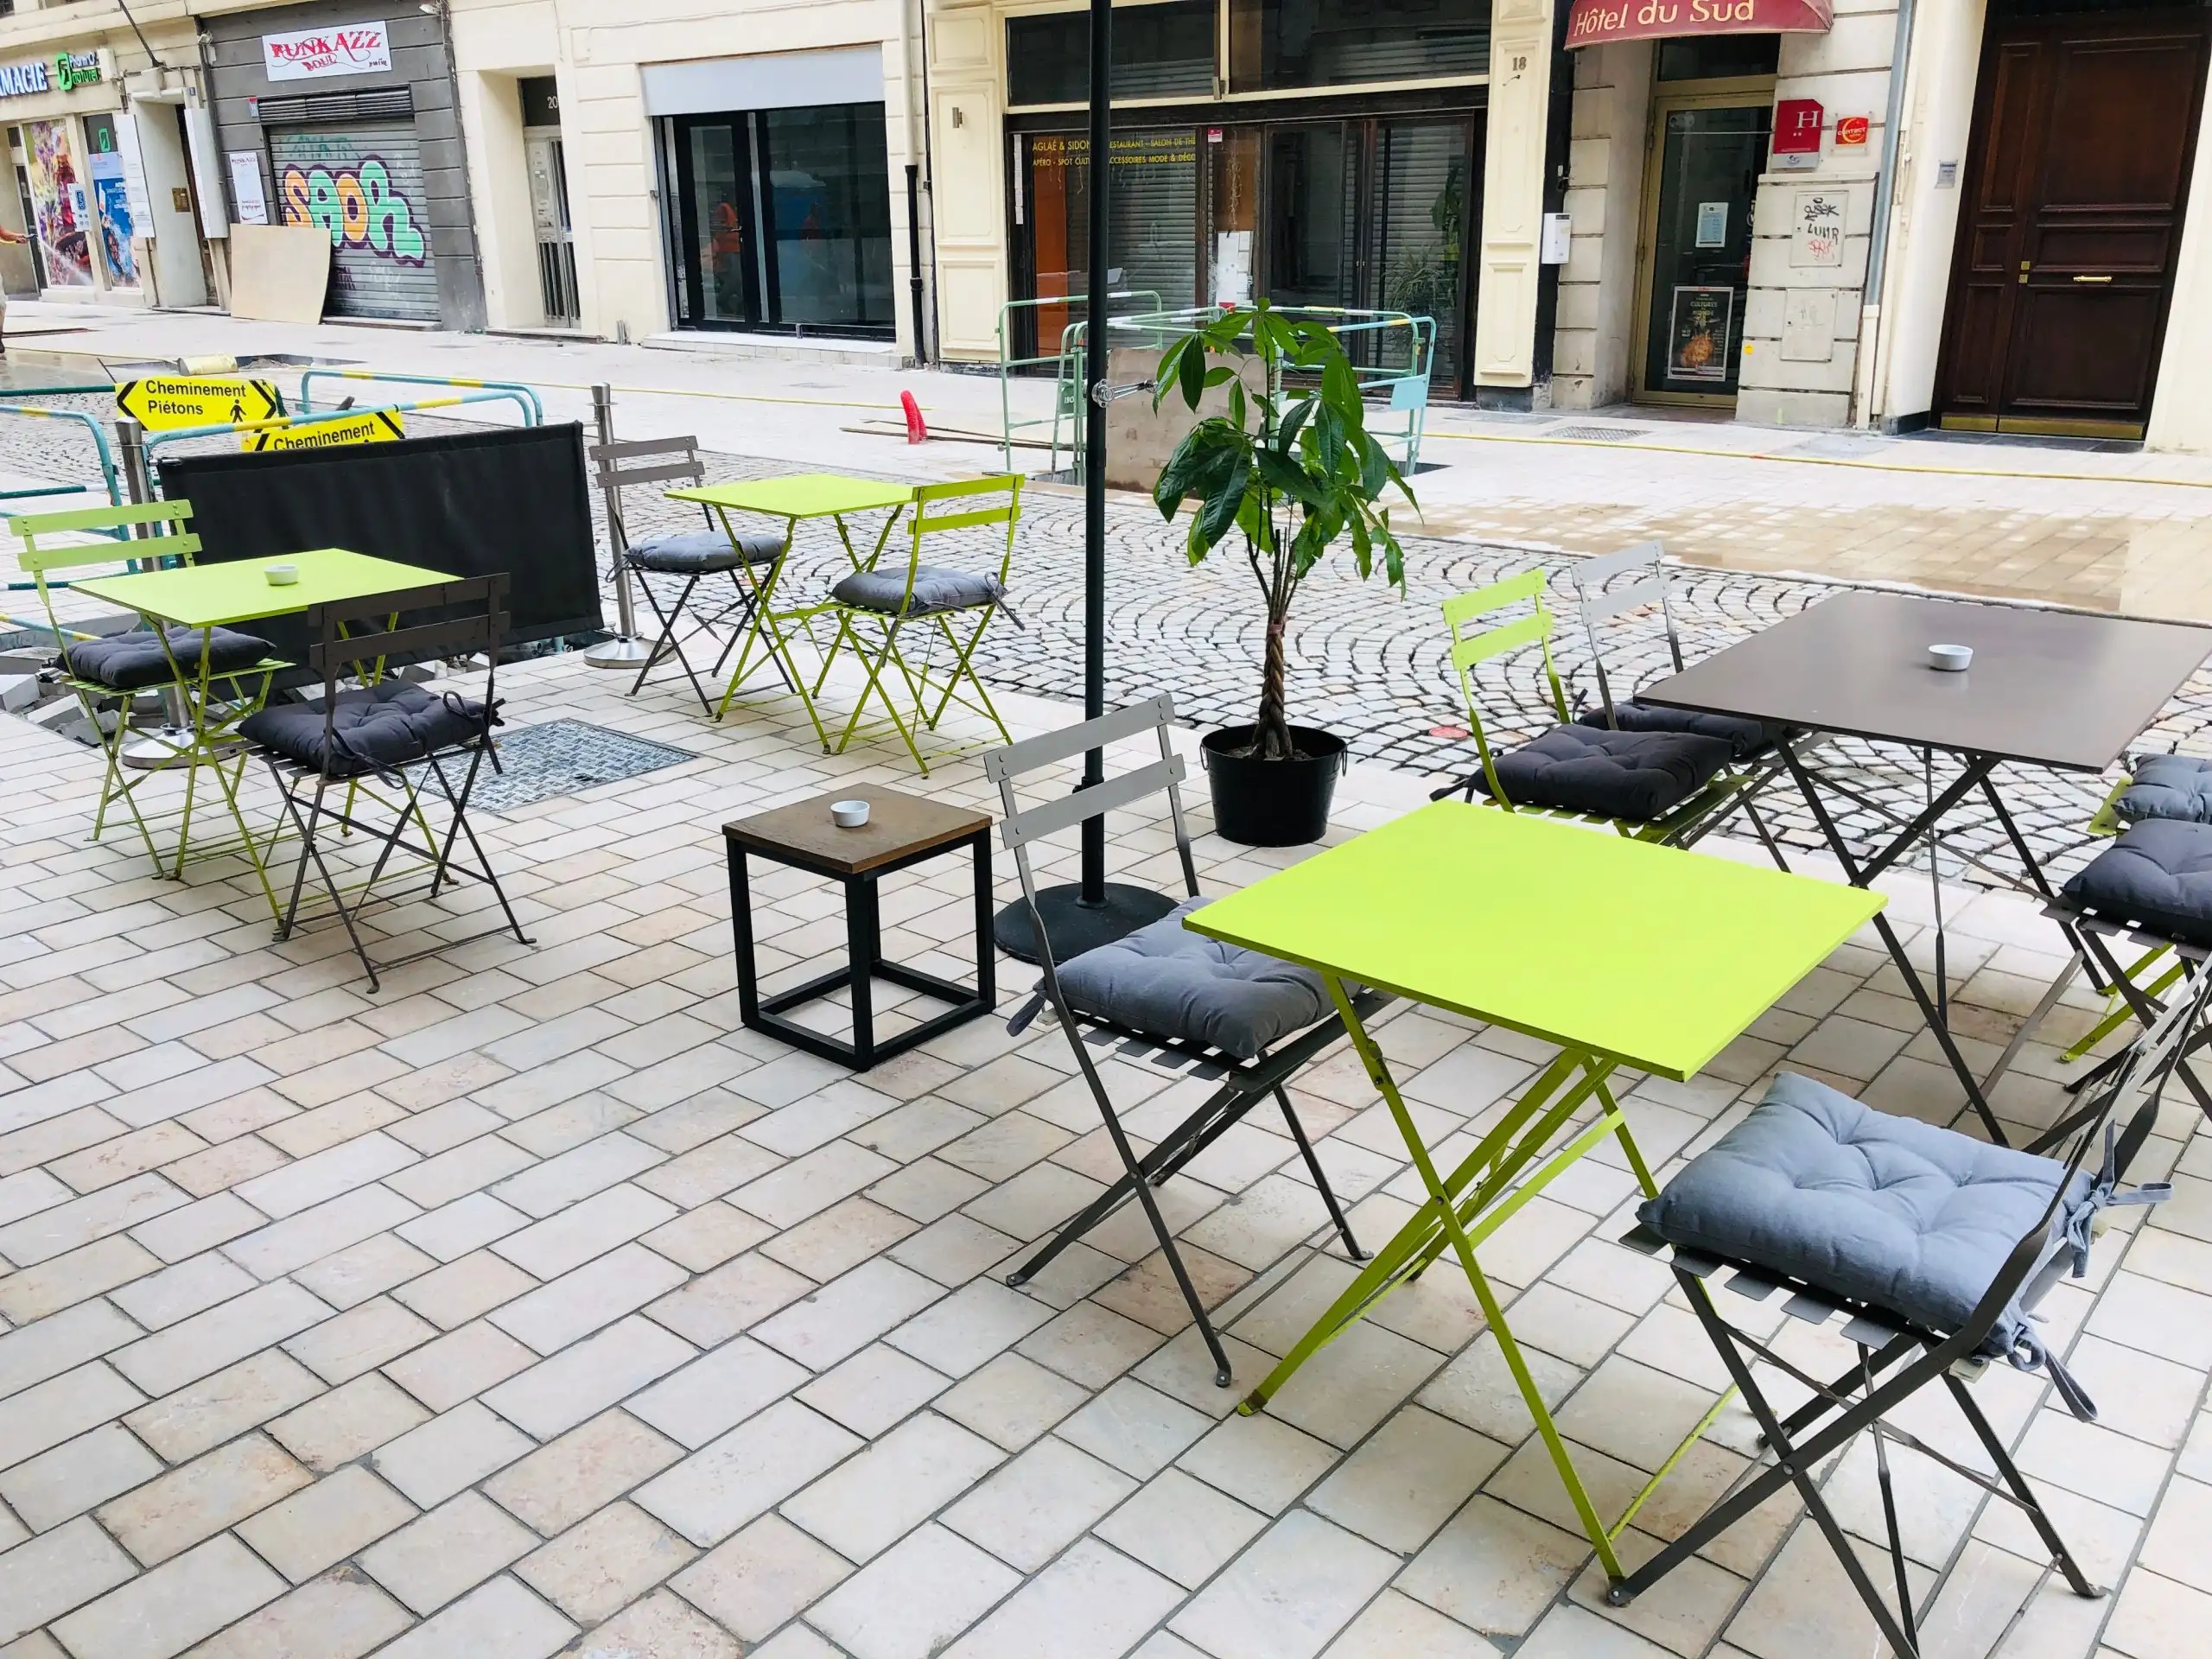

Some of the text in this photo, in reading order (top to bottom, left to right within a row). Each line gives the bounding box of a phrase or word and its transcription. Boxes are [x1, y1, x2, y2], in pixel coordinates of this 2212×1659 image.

[1573, 0, 1755, 37] Hôtel du Sud
[1512, 56, 1527, 71] 18
[547, 96, 558, 109] 20
[1796, 111, 1821, 129] H
[1033, 139, 1058, 151] AGLAÉ
[1067, 140, 1090, 151] SIDON
[1109, 139, 1144, 149] ESTAURANT
[1150, 138, 1173, 148] SALON
[1058, 157, 1072, 167] SPOT
[1148, 155, 1168, 163] MODE
[145, 379, 246, 398] Cheminement
[148, 399, 204, 416] Piétons
[273, 421, 375, 449] Cheminement
